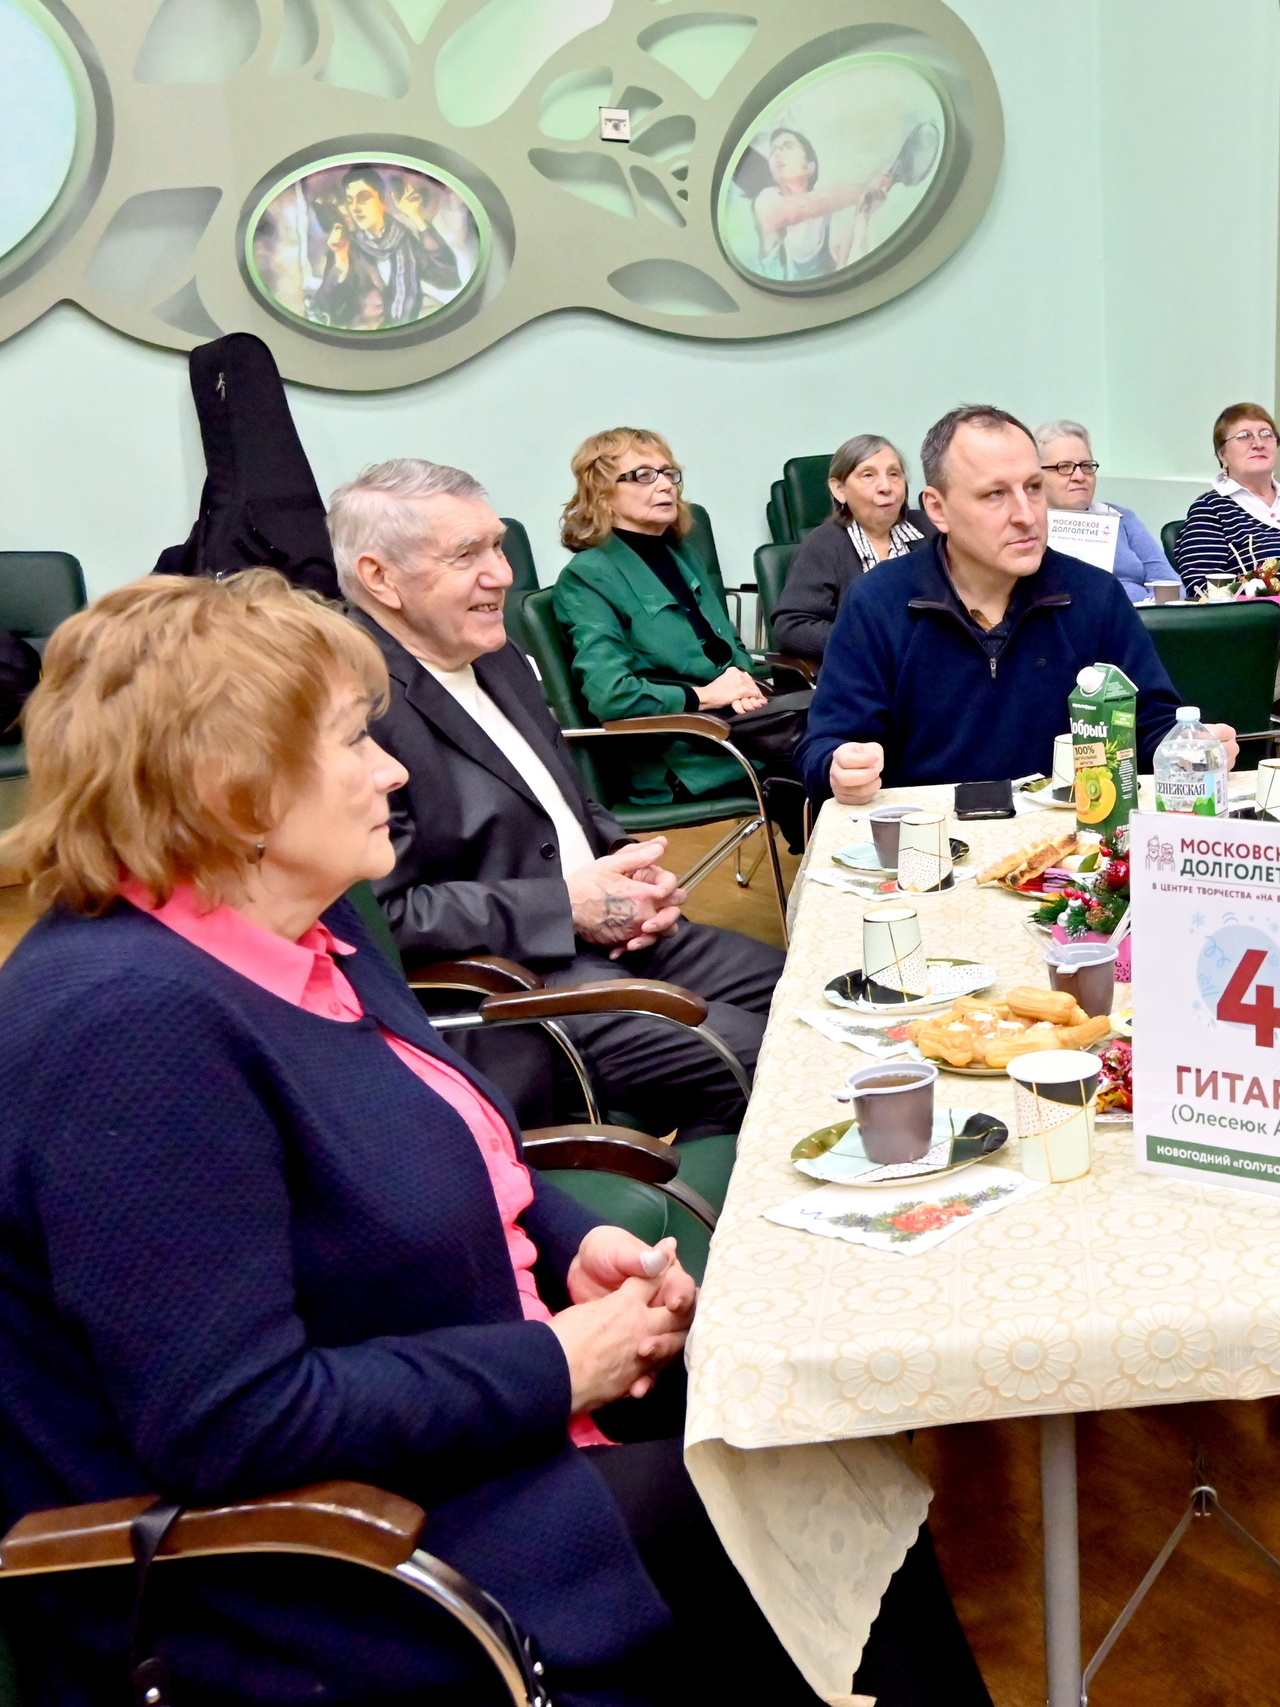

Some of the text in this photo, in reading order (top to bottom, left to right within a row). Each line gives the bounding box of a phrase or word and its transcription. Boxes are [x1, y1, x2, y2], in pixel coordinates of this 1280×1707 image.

[1052, 526, 1099, 536] ДОЛГОЛЕТИЕ
[1053, 519, 1099, 529] МОСКОВСКОЕ
[1075, 745, 1095, 755] 100%
[1152, 882, 1158, 890] В
[1160, 883, 1194, 895] ЦЕНТРЕ
[1197, 887, 1252, 899] ТВОРЧЕСТВА
[1255, 894, 1273, 902] «НА
[1171, 1104, 1267, 1135] (Олесеюк
[1156, 1145, 1231, 1168] НОВОГОДНИЙ
